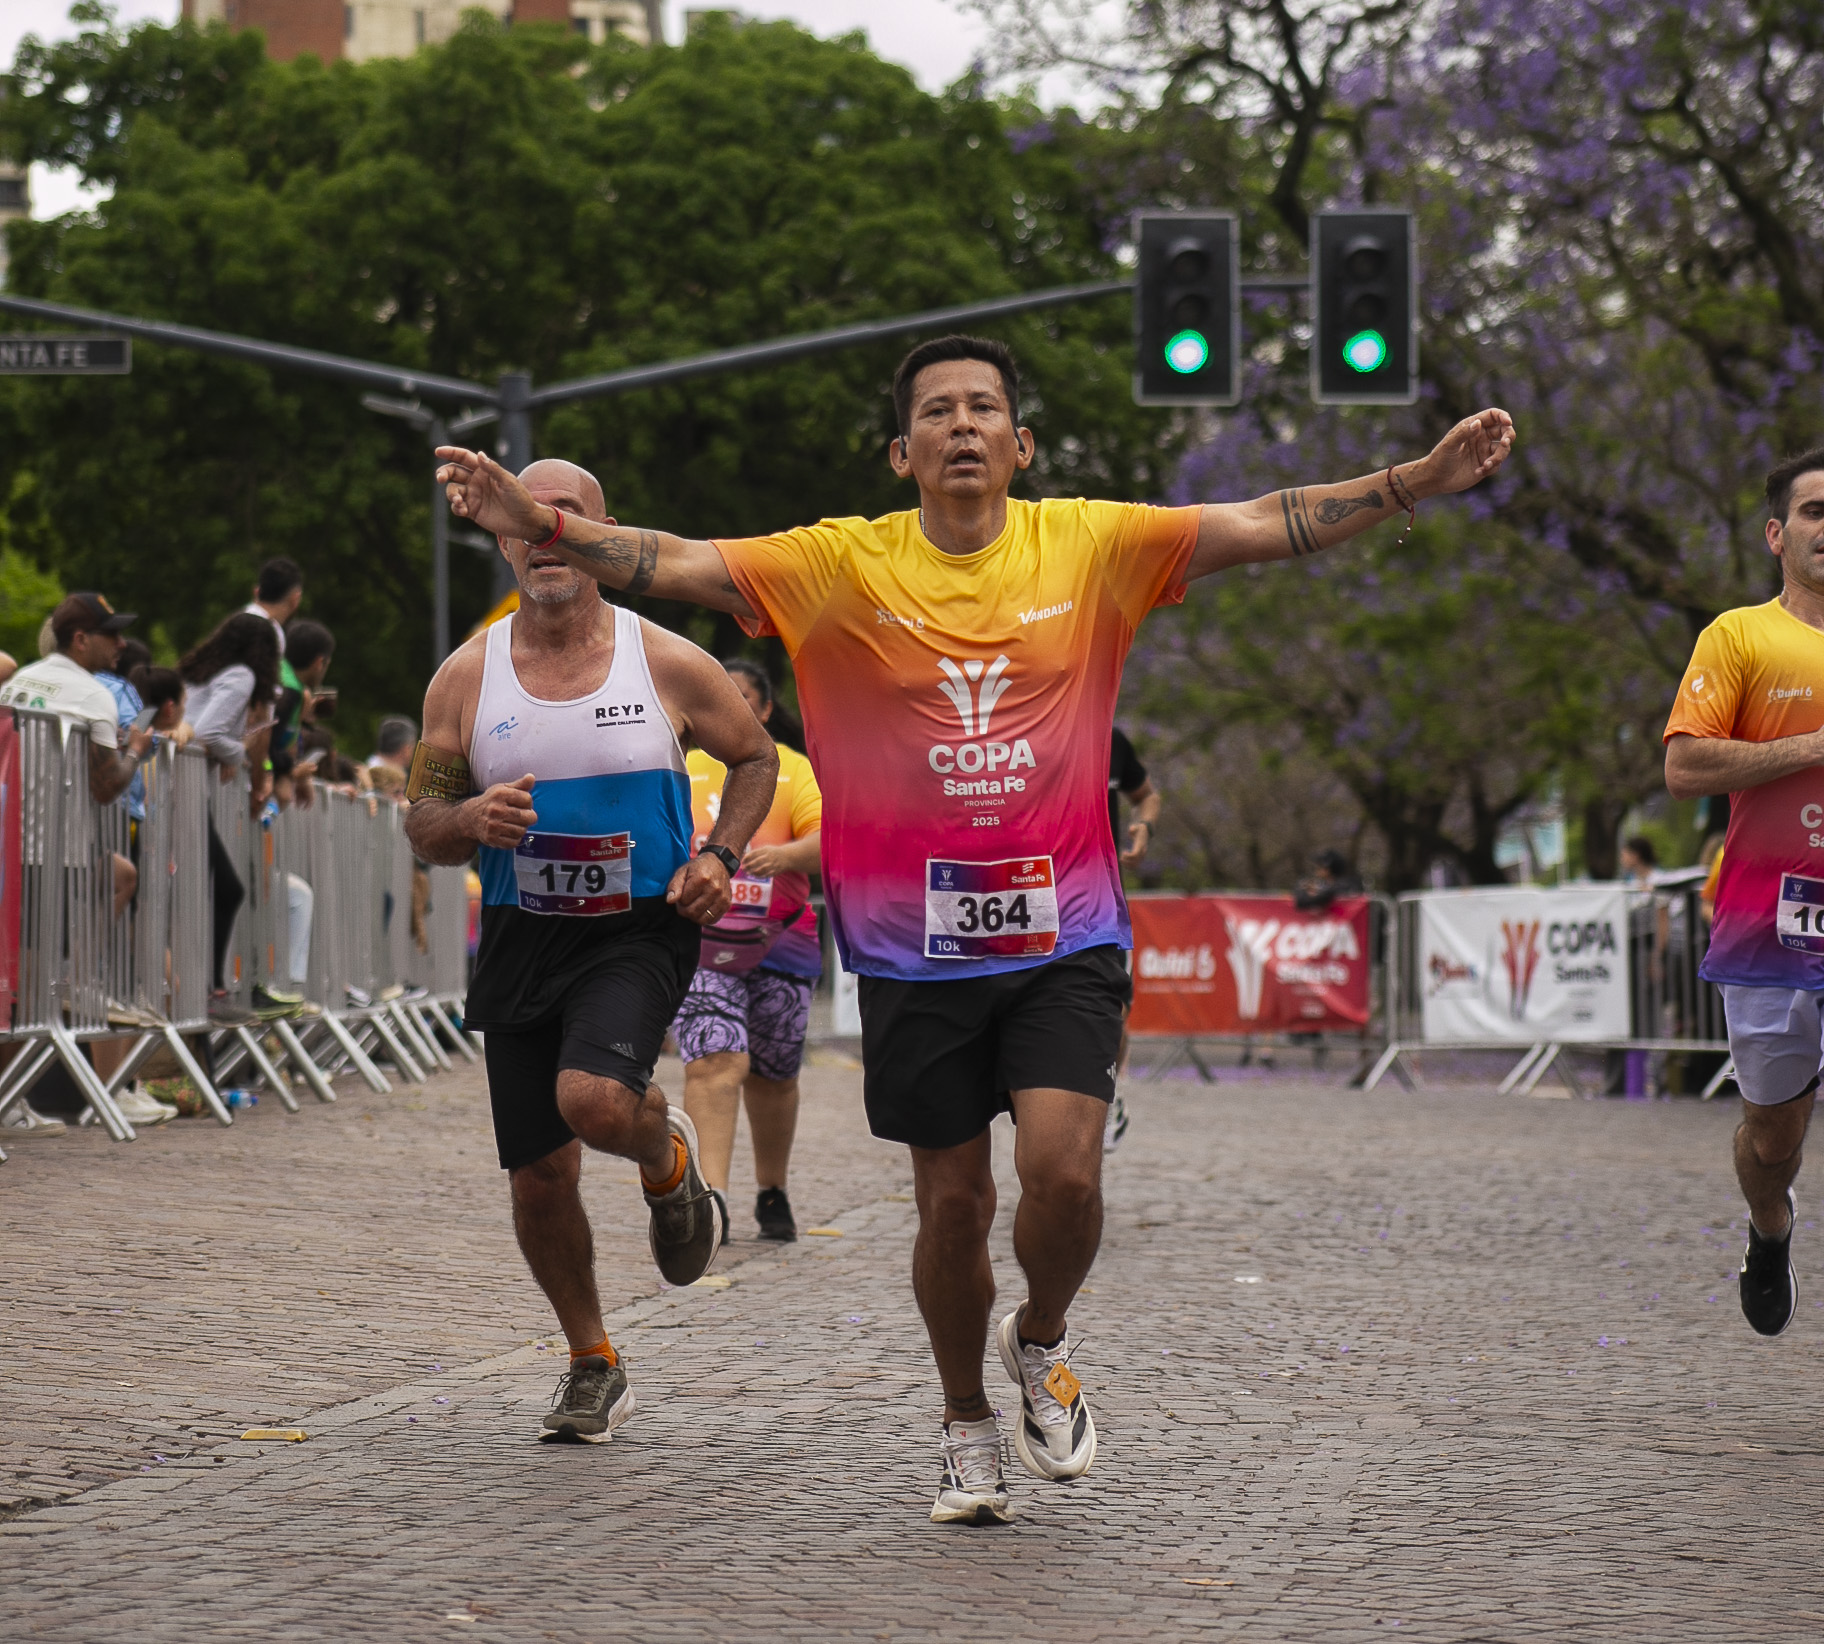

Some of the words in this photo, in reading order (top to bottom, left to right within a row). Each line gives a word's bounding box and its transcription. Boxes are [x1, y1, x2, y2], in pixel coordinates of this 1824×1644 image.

[55, 343, 89, 367] FE
[1017, 600, 1073, 624] VANDALIA
[1804, 686, 1813, 698] 6
[595, 704, 644, 719] RCYP
[497, 731, 512, 741] aire
[928, 738, 1037, 774] COPA
[943, 779, 1002, 796] Santa
[1003, 776, 1026, 793] Fe
[964, 798, 1006, 807] PROVINCIA
[972, 816, 1000, 827] 2025
[590, 849, 613, 857] Santa
[538, 863, 607, 894] 179
[1011, 875, 1037, 884] Santa
[1036, 873, 1046, 882] Fe
[524, 895, 542, 909] 10k
[956, 893, 1032, 934] 364
[1274, 919, 1359, 960] COPA
[1547, 922, 1616, 955] COPA
[1786, 938, 1807, 949] 10k
[937, 940, 961, 952] 10k
